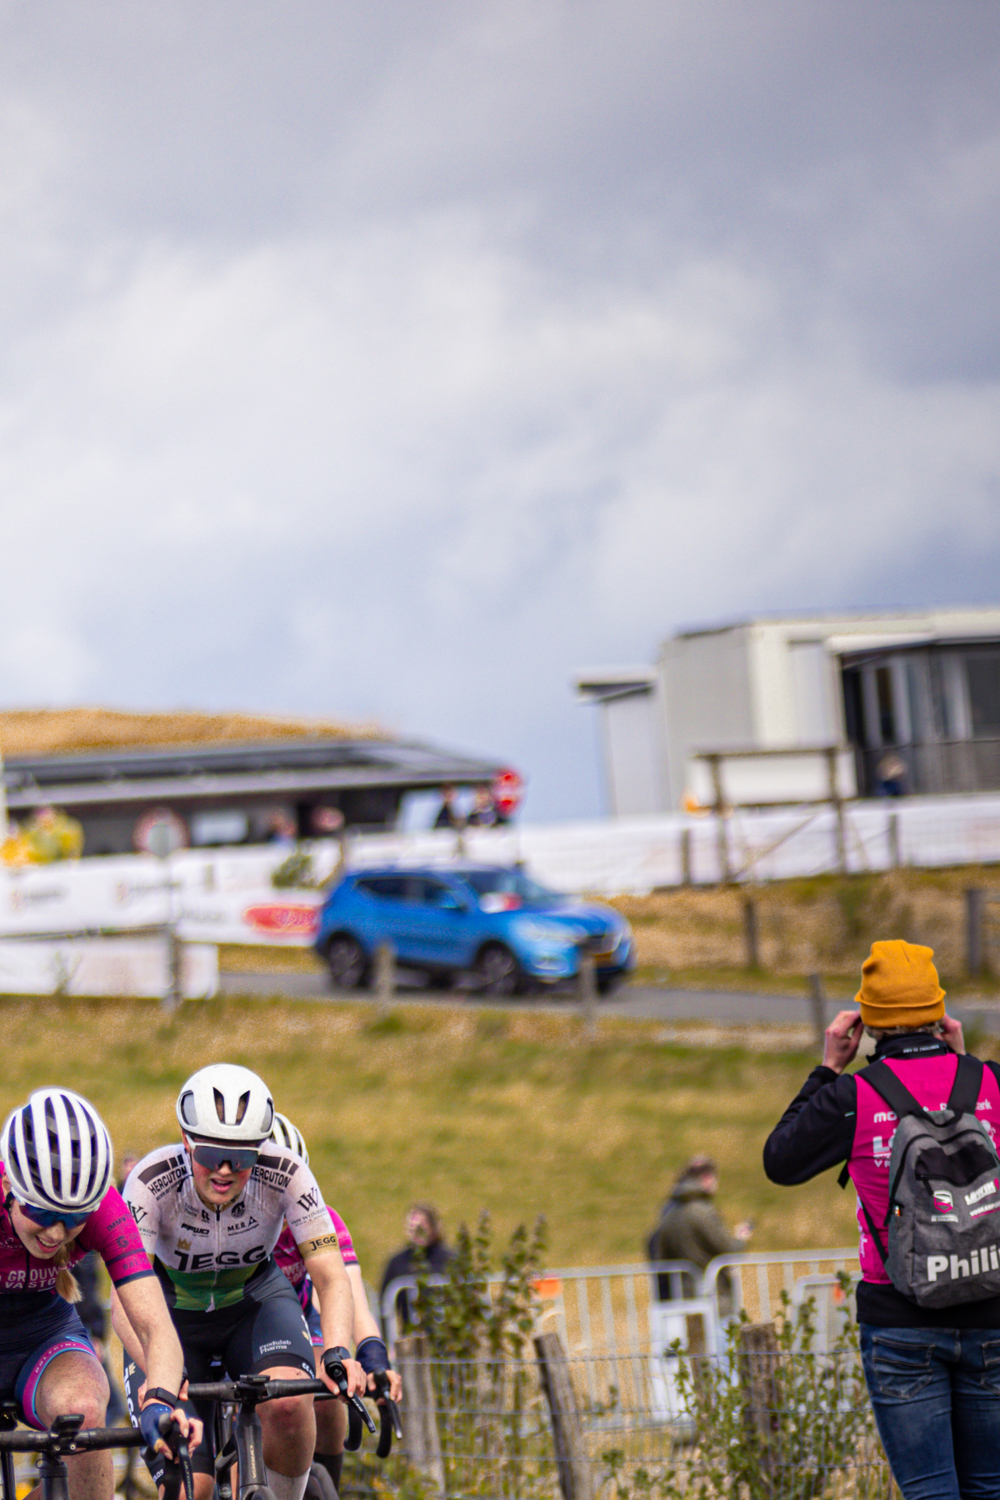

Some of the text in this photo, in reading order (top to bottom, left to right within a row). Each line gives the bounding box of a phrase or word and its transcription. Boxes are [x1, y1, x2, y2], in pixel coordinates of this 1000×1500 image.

[147, 1165, 188, 1196] HERCUTON
[309, 1236, 336, 1252] JEGG
[174, 1245, 267, 1272] JEGG
[926, 1244, 1000, 1282] Phili
[5, 1278, 56, 1289] VASTG
